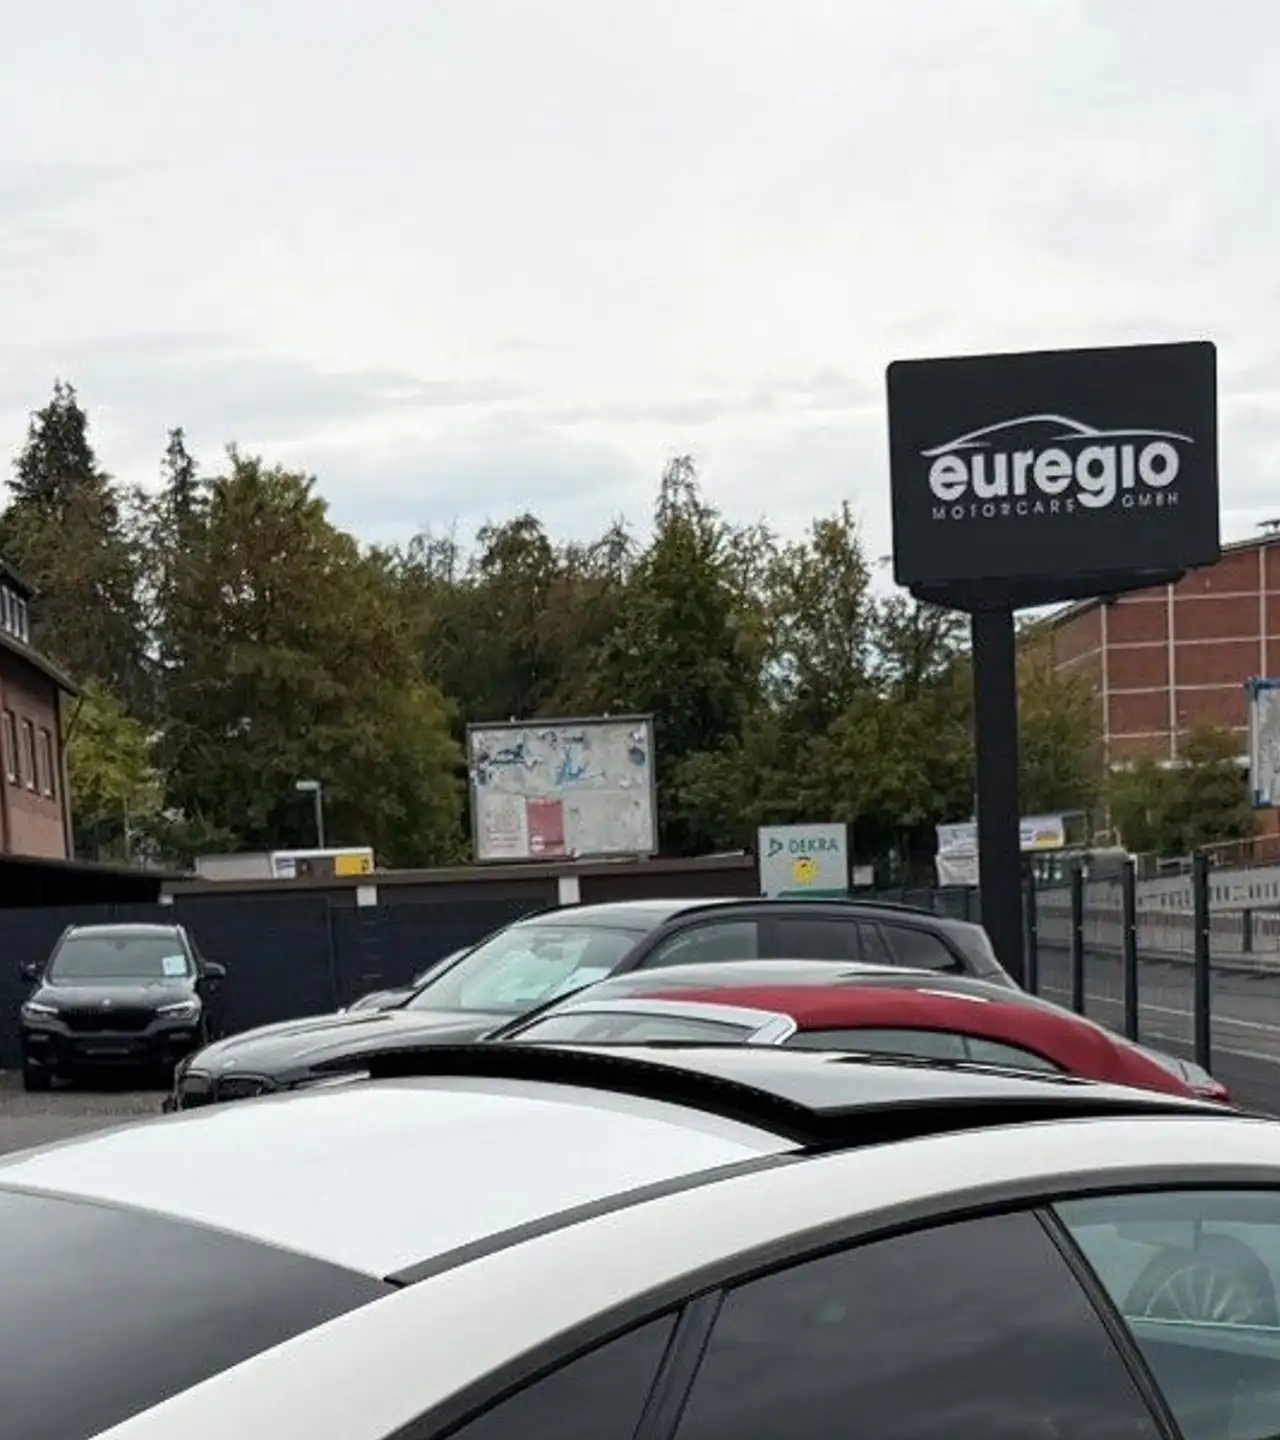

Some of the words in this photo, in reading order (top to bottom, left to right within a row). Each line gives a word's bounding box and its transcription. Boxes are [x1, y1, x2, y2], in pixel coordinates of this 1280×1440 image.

[929, 441, 1180, 509] euregio
[931, 498, 1076, 520] MOTORCARS
[788, 837, 839, 854] DEKRA
